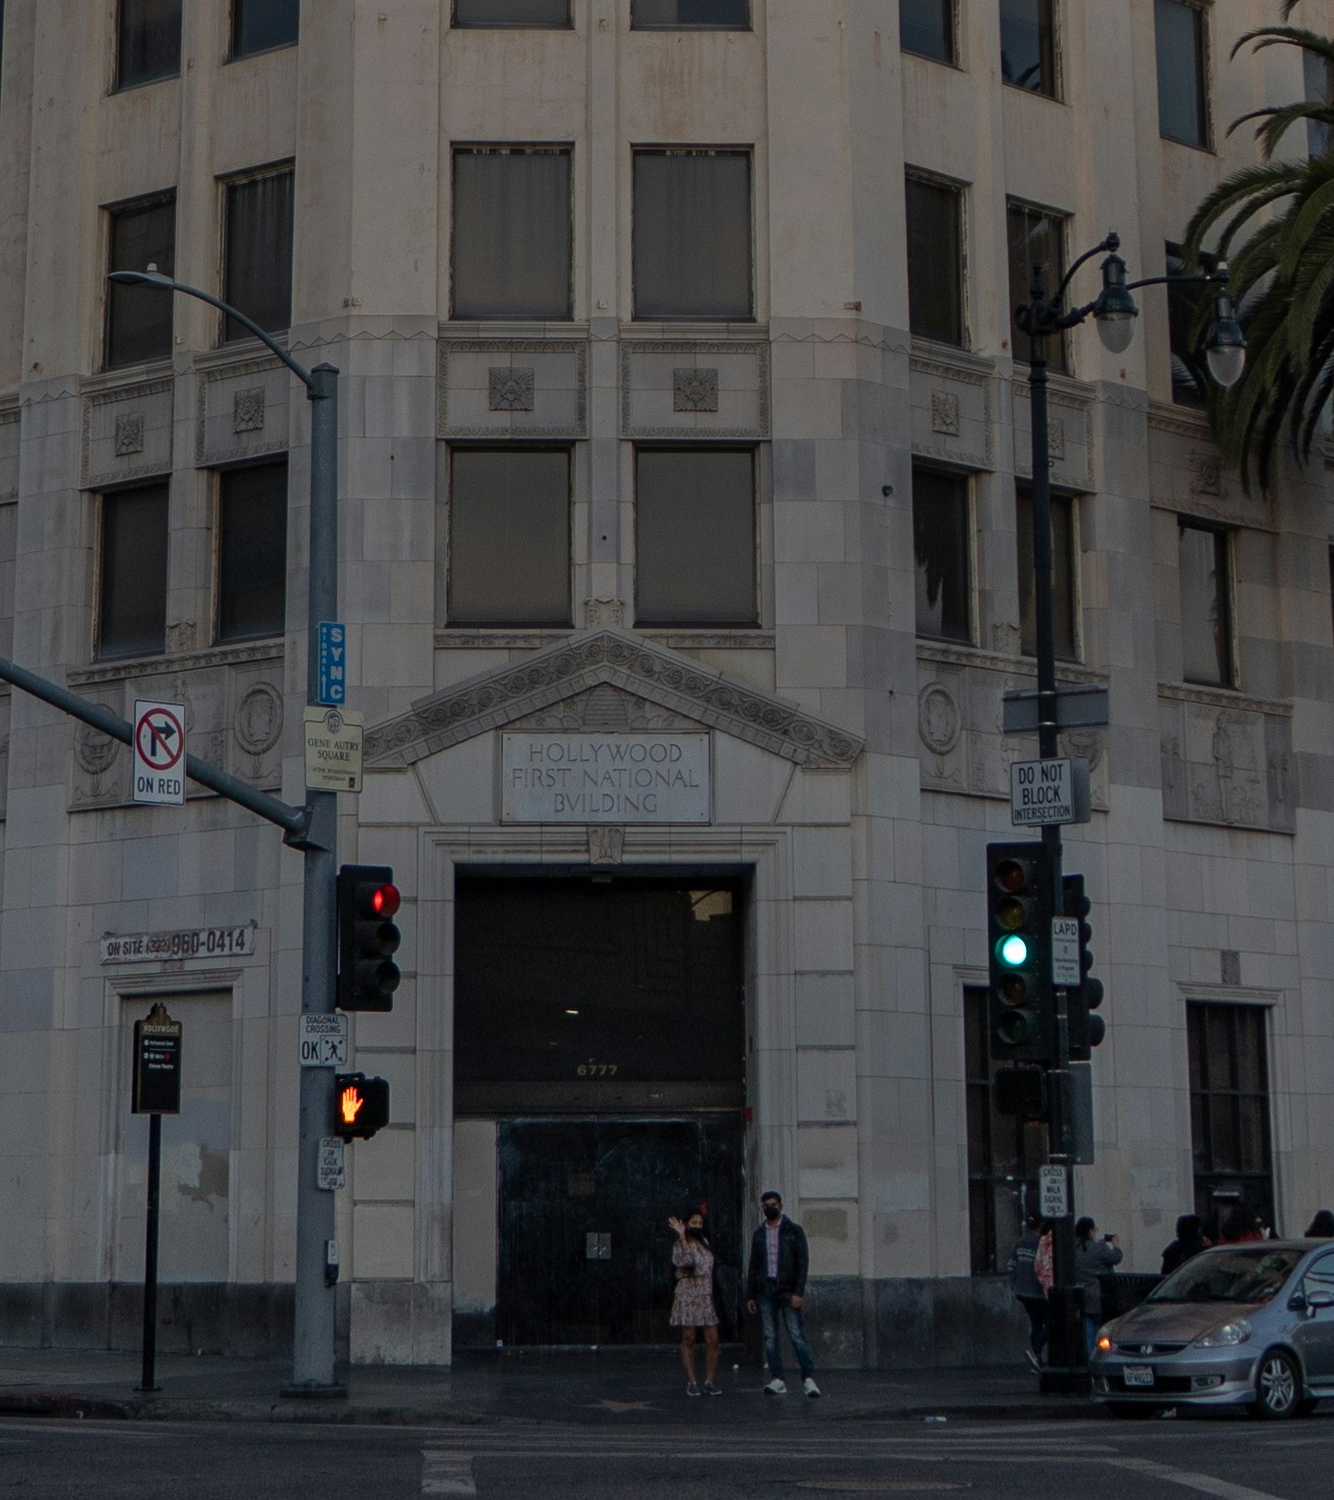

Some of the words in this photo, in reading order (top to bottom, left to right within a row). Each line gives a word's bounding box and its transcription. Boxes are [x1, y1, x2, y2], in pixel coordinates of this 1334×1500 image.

[330, 627, 343, 700] SYNC
[308, 738, 331, 748] GENE
[334, 741, 360, 751] AUTRY
[529, 743, 682, 763] HOLLYWOOD
[317, 750, 351, 761] SQUARE
[512, 768, 571, 788] FIRST
[583, 768, 699, 788] NATIONAL
[1019, 766, 1034, 784] DO
[1041, 764, 1064, 783] NOT
[137, 776, 153, 794] ON
[158, 778, 181, 796] RED
[1022, 785, 1061, 805] BLOCK
[554, 793, 657, 813] BVILDING
[1015, 804, 1070, 820] INTERSECTION
[1054, 922, 1077, 936] LAPD
[122, 939, 143, 954] SITE
[302, 1041, 319, 1060] OK
[576, 1064, 618, 1076] 6777
